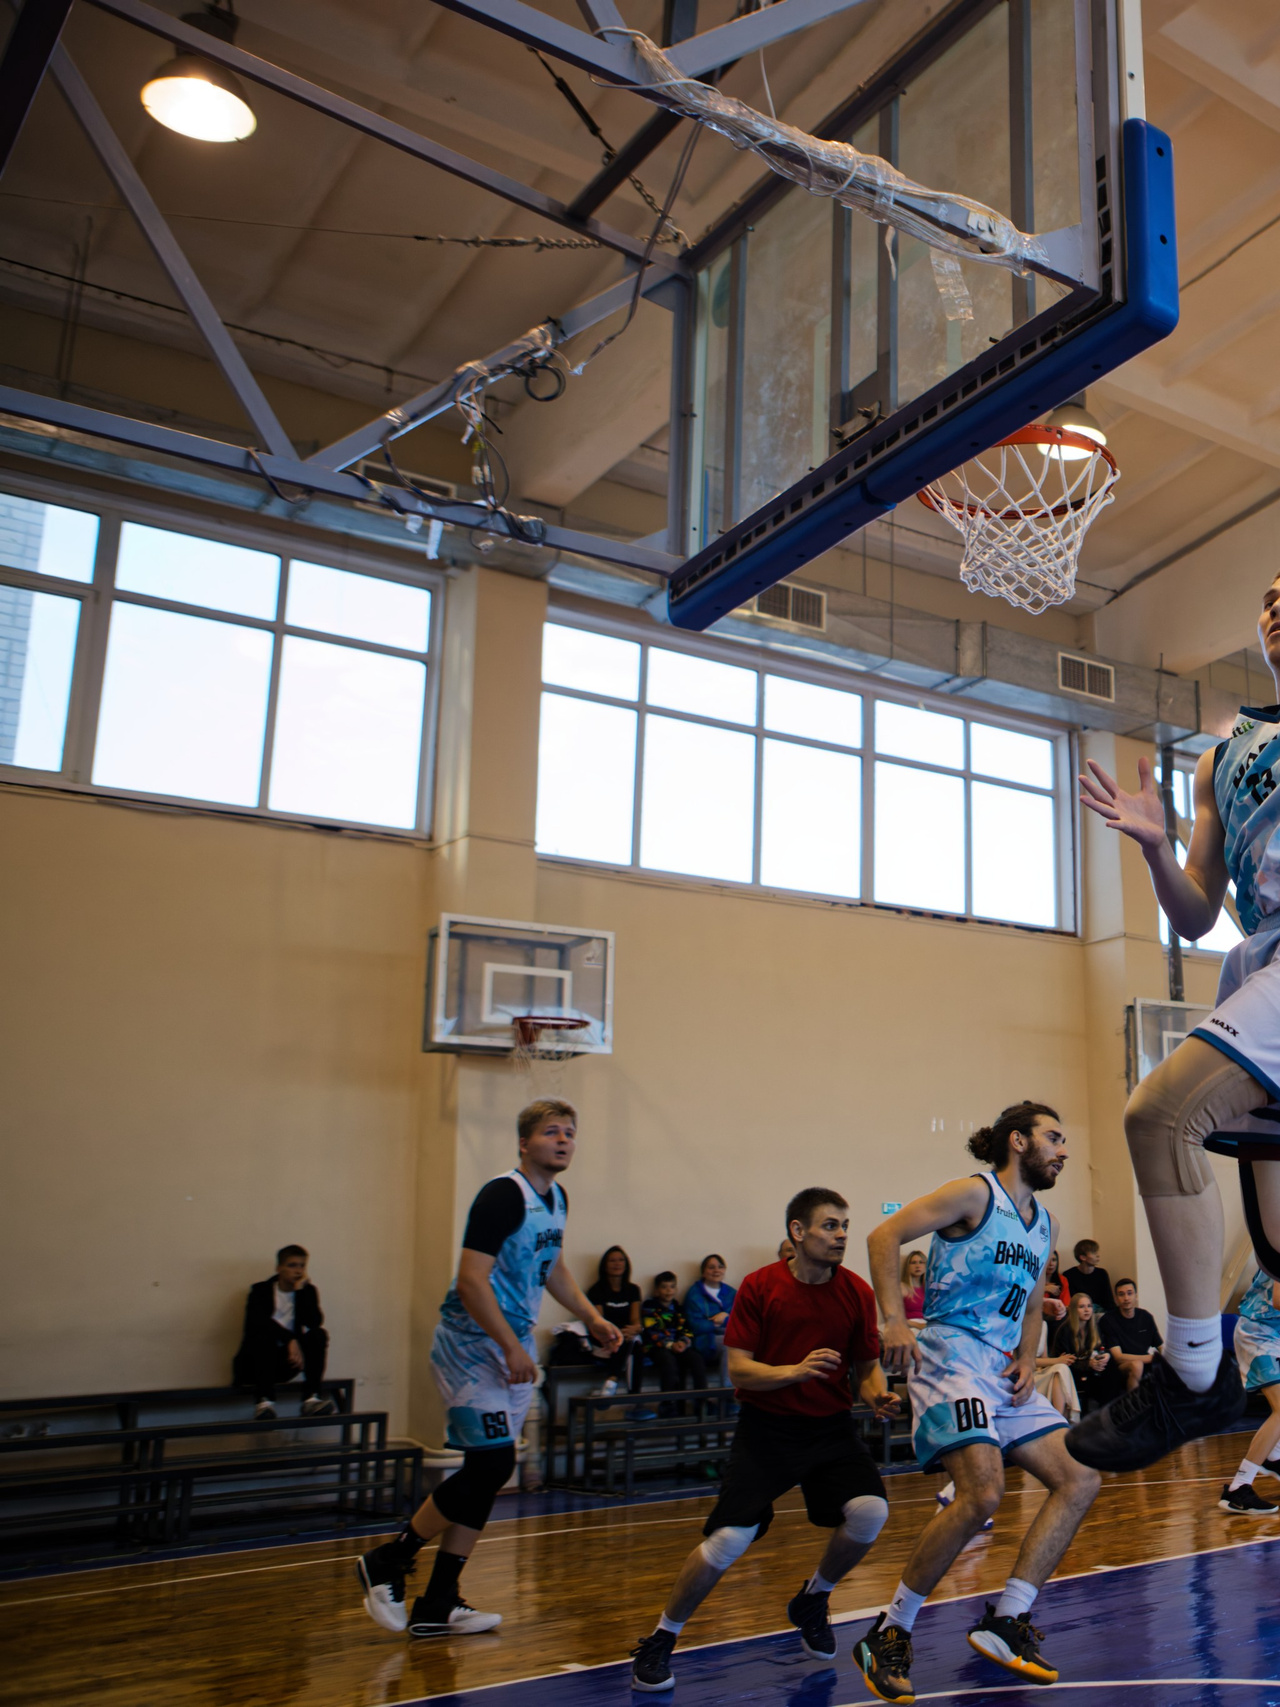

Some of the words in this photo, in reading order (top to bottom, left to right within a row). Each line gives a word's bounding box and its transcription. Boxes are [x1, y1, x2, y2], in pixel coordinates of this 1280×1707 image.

[1209, 1017, 1240, 1038] MAXX
[996, 1206, 1019, 1222] fruitit
[482, 1410, 510, 1439] 69
[955, 1397, 988, 1432] 00
